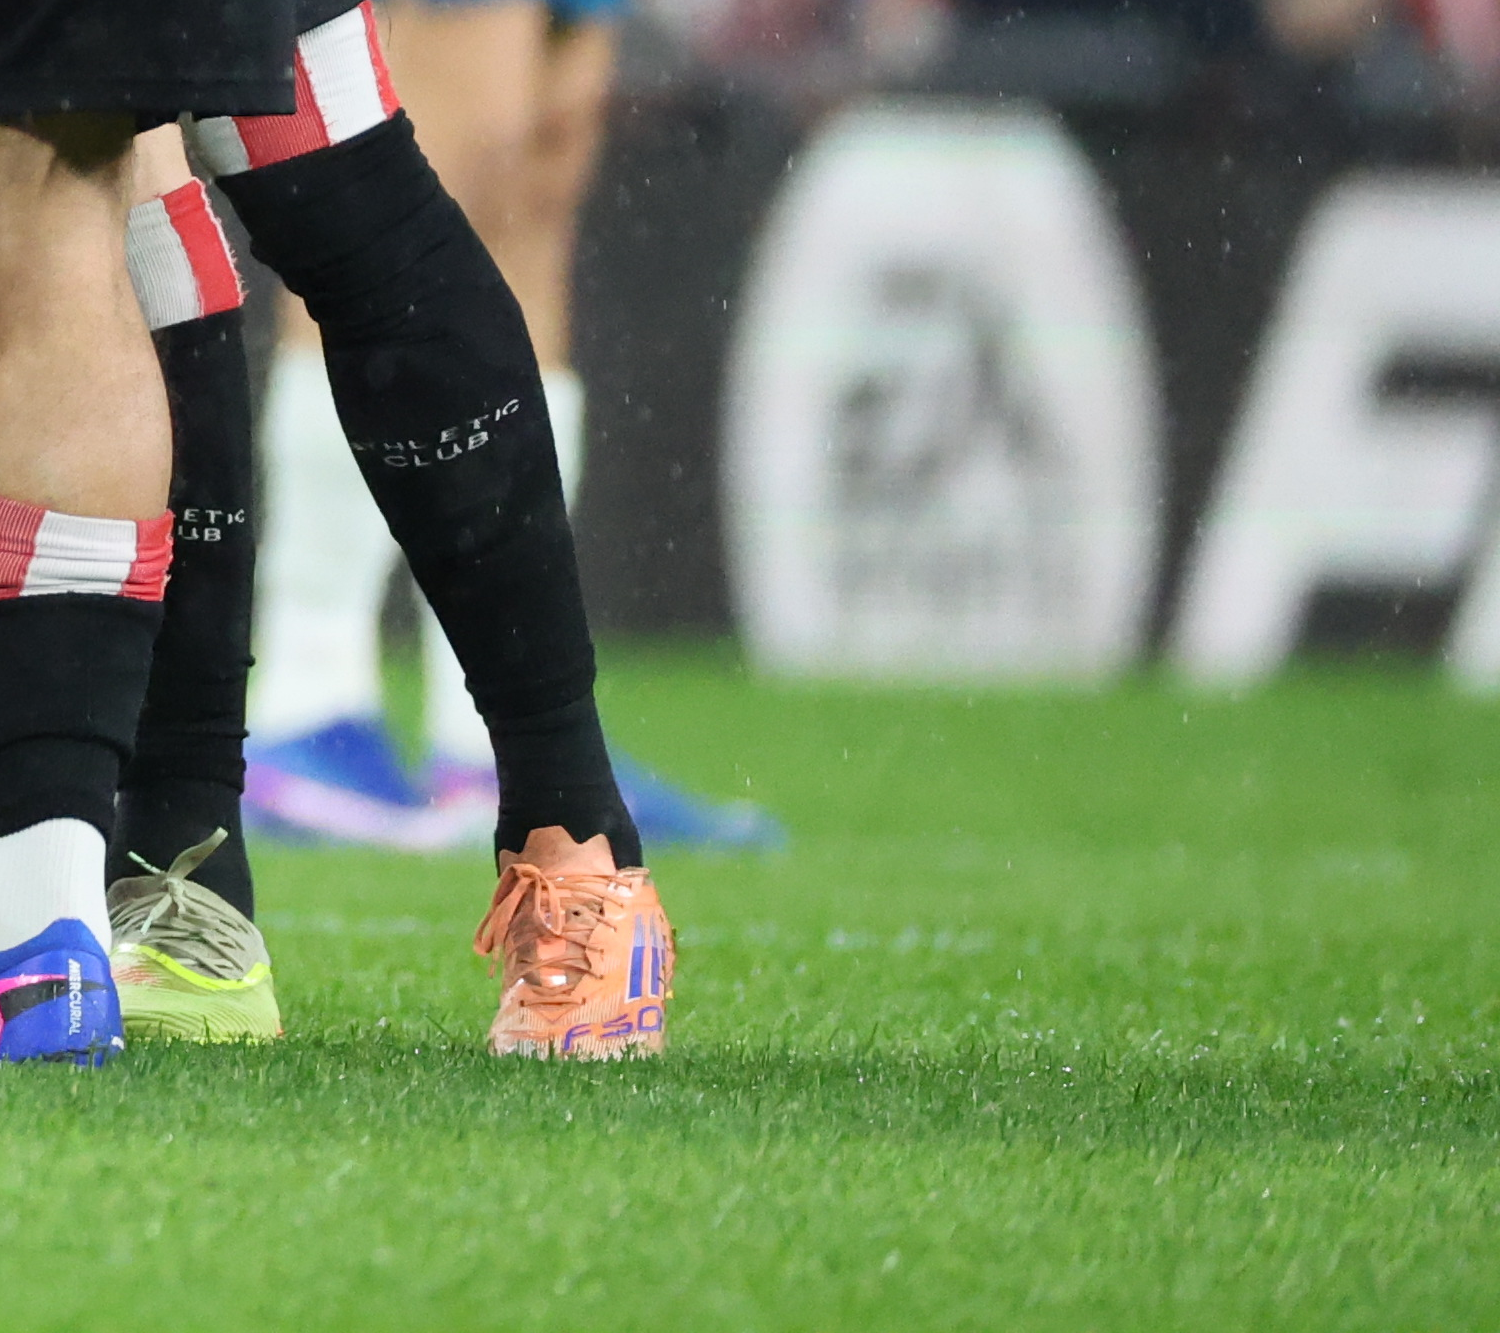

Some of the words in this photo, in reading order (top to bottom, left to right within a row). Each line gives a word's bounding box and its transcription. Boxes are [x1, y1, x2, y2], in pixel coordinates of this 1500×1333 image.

[383, 431, 489, 468] CLUB
[182, 507, 246, 525] ETIC
[177, 524, 222, 542] UB
[67, 958, 82, 1036] MERCURIAL
